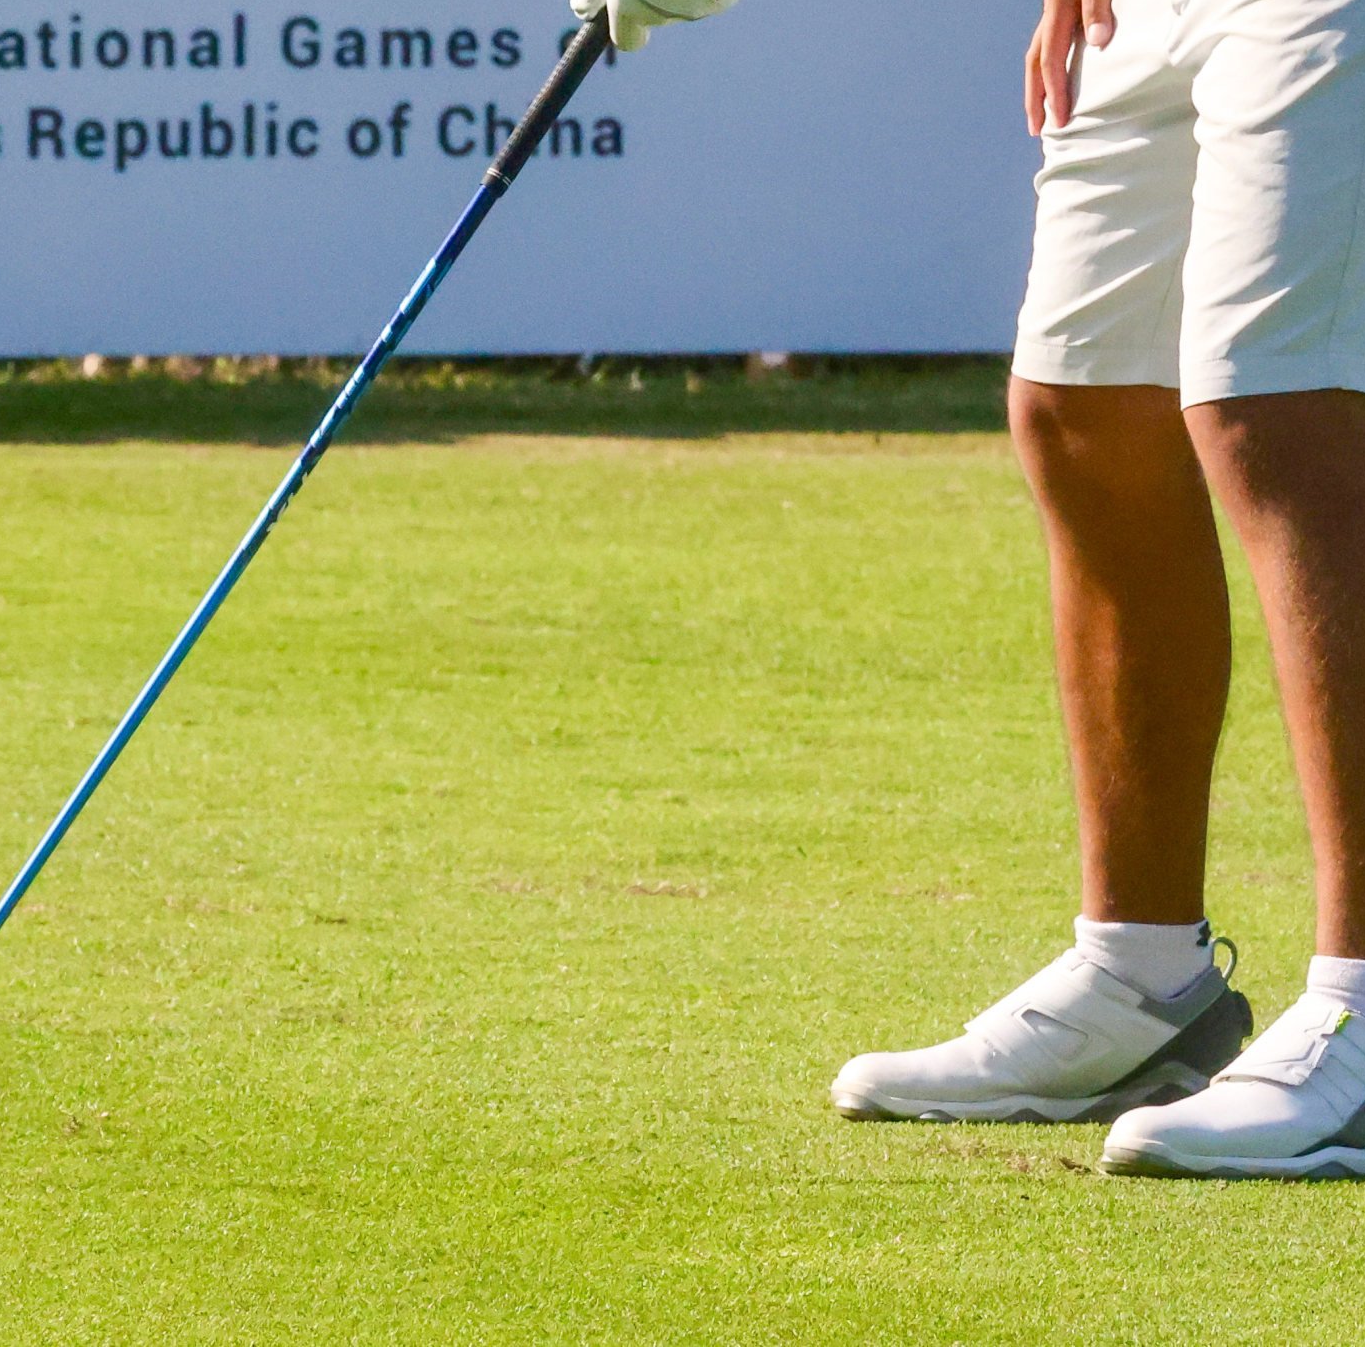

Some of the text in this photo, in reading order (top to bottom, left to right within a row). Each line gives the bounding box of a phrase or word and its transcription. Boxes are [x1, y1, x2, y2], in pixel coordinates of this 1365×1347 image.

[280, 15, 522, 70] Games
[26, 102, 320, 174] Republic
[346, 101, 412, 160] of
[436, 101, 625, 160] Chna
